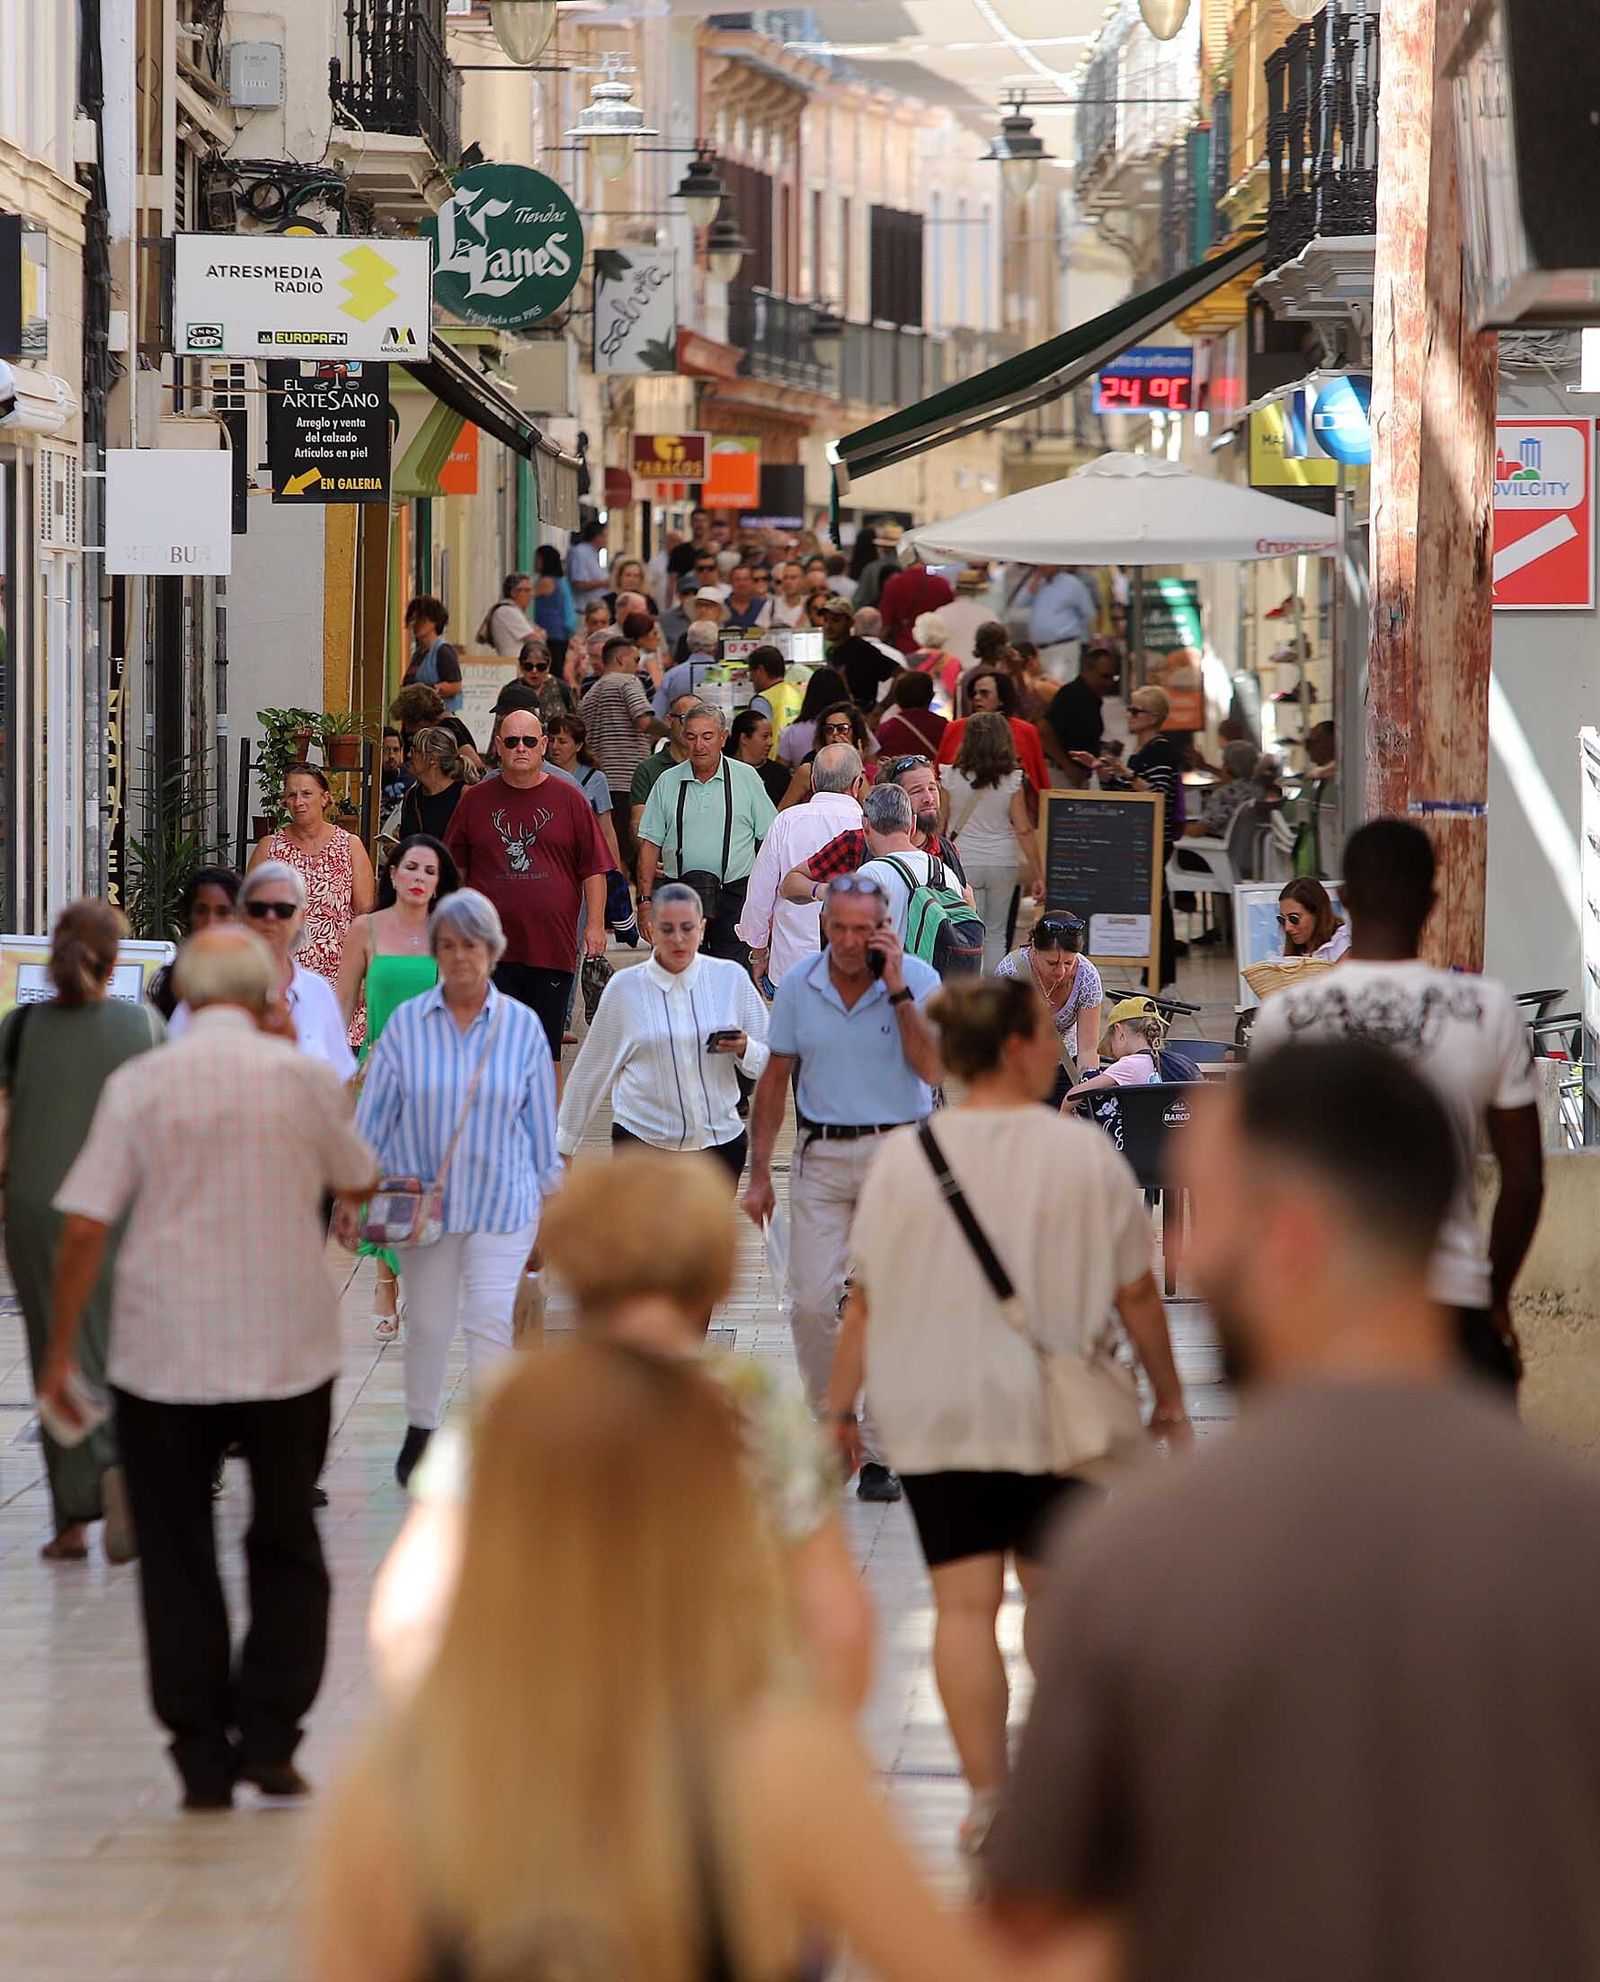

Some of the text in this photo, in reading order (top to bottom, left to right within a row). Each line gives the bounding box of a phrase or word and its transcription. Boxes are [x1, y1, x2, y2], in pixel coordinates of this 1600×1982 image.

[514, 203, 567, 224] Tiendas
[206, 265, 323, 279] ATRESMEDIA
[274, 281, 323, 294] RADIO
[284, 379, 303, 391] EL
[1100, 377, 1142, 408] 24
[296, 416, 366, 430] Arreglo y venta
[305, 431, 358, 443] del calzado
[336, 449, 348, 458] en
[350, 446, 368, 459] piel
[320, 477, 383, 490] EN GALERIA
[1164, 1112, 1191, 1122] BARCO
